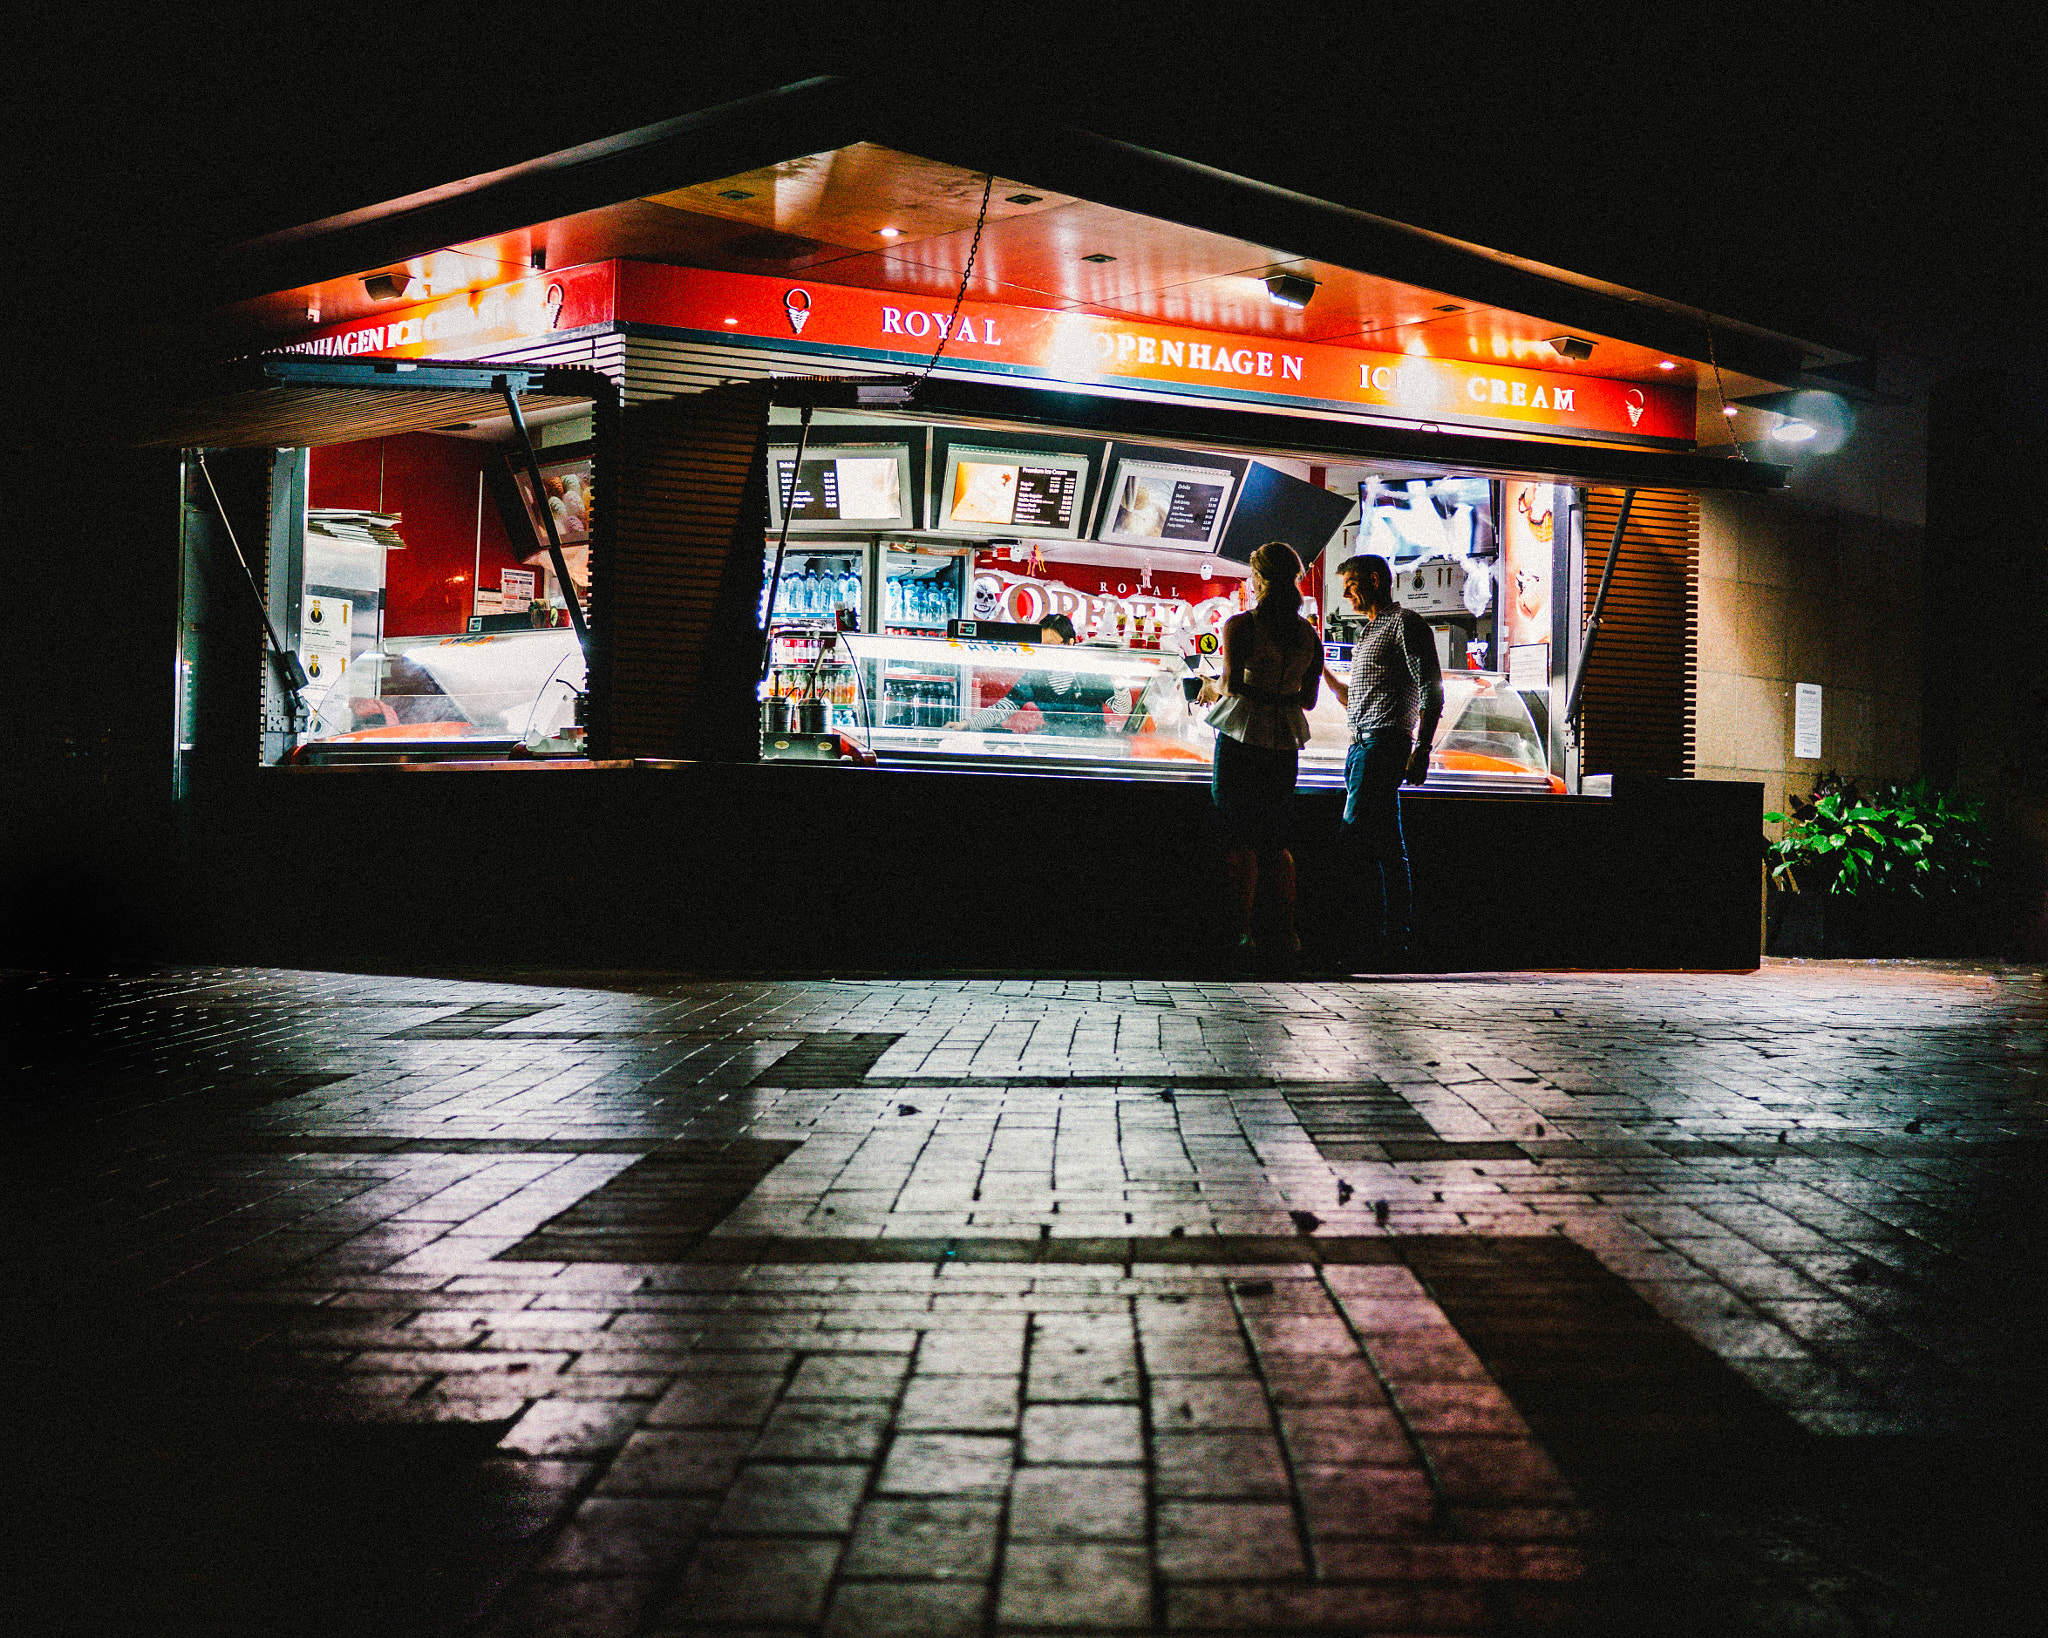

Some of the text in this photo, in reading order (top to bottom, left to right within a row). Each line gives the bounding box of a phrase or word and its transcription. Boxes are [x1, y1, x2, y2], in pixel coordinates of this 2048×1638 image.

[882, 307, 1575, 412] ROYAL OPENHAGEN IC CREAM
[1100, 582, 1179, 597] ROYAL
